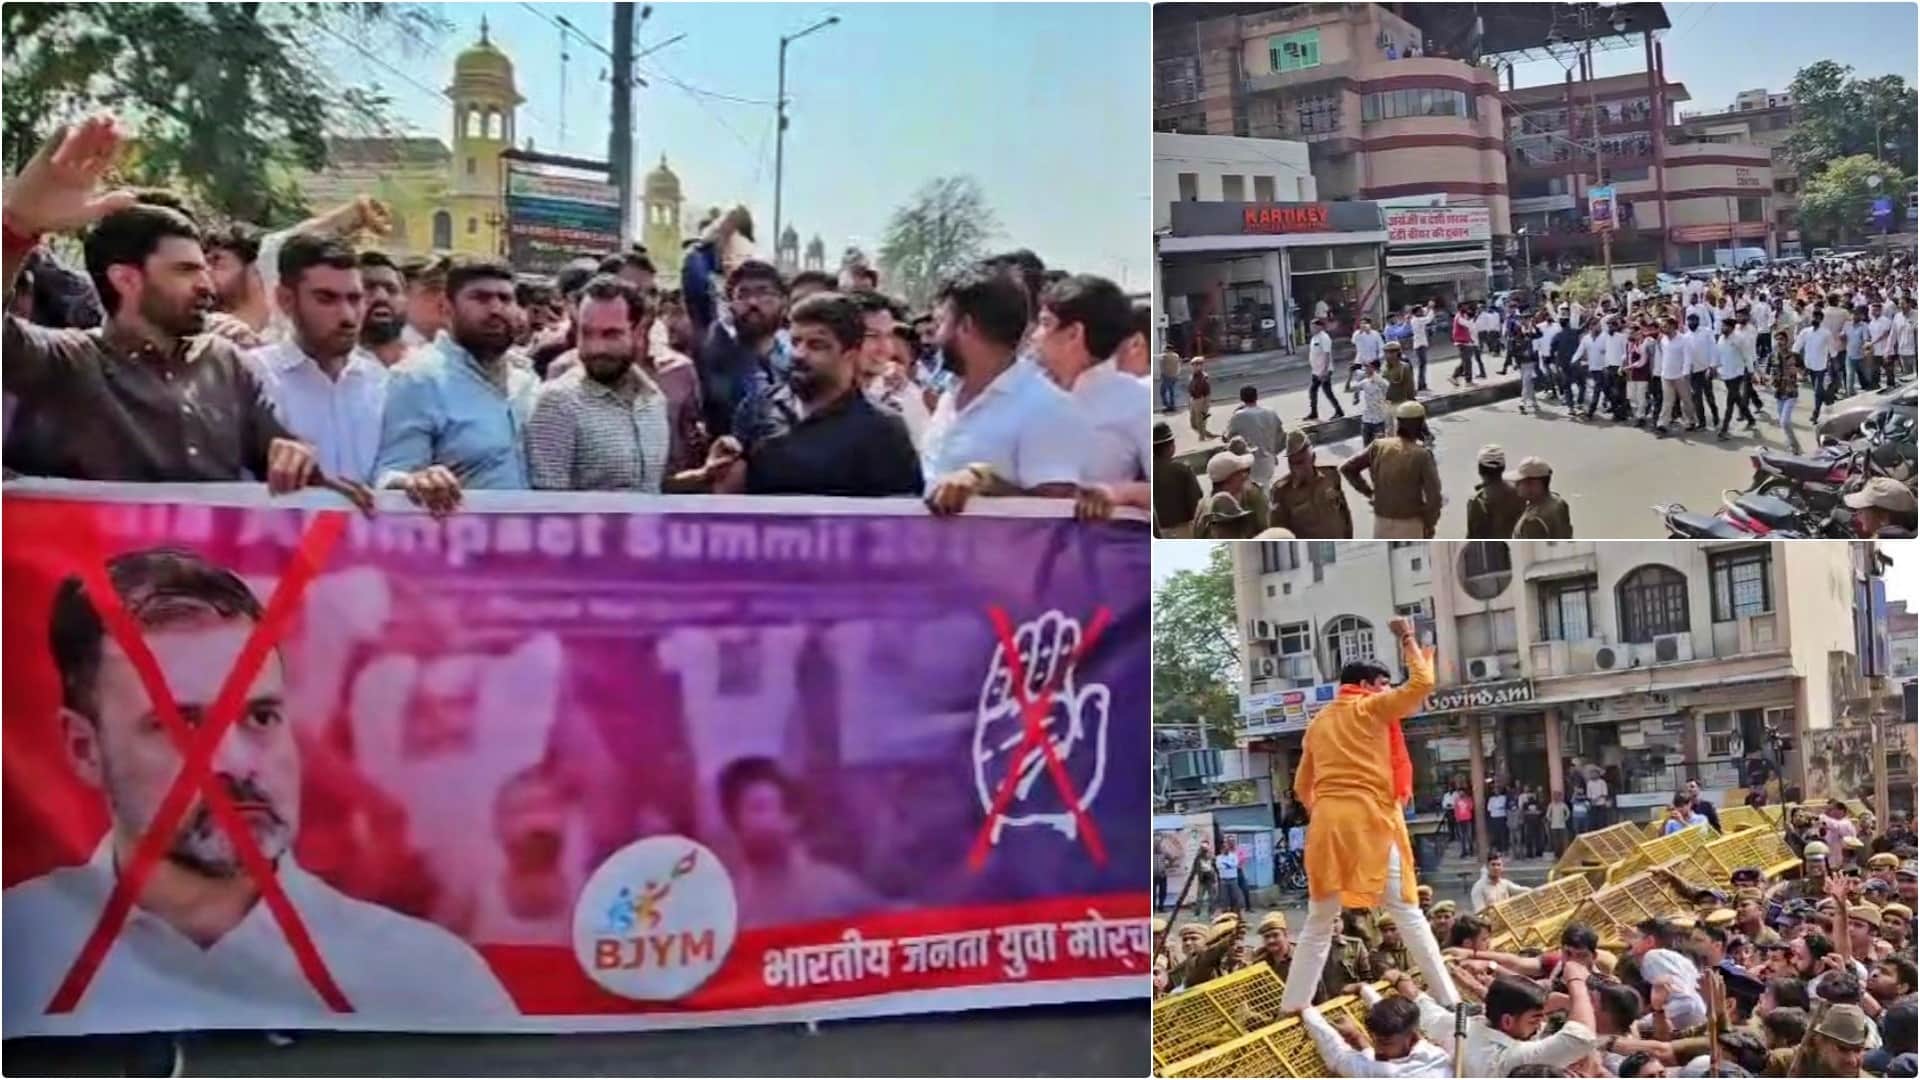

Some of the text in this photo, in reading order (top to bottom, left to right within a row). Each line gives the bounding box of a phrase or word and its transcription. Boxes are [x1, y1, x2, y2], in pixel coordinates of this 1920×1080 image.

[1244, 206, 1329, 225] KARTIKEY
[350, 511, 602, 566] Impact
[629, 513, 854, 560] Summit
[1424, 686, 1530, 711] Govindam
[595, 929, 715, 970] BJYM
[763, 927, 893, 988] भारतीय
[897, 928, 992, 973] जनता
[995, 922, 1058, 978] युवा
